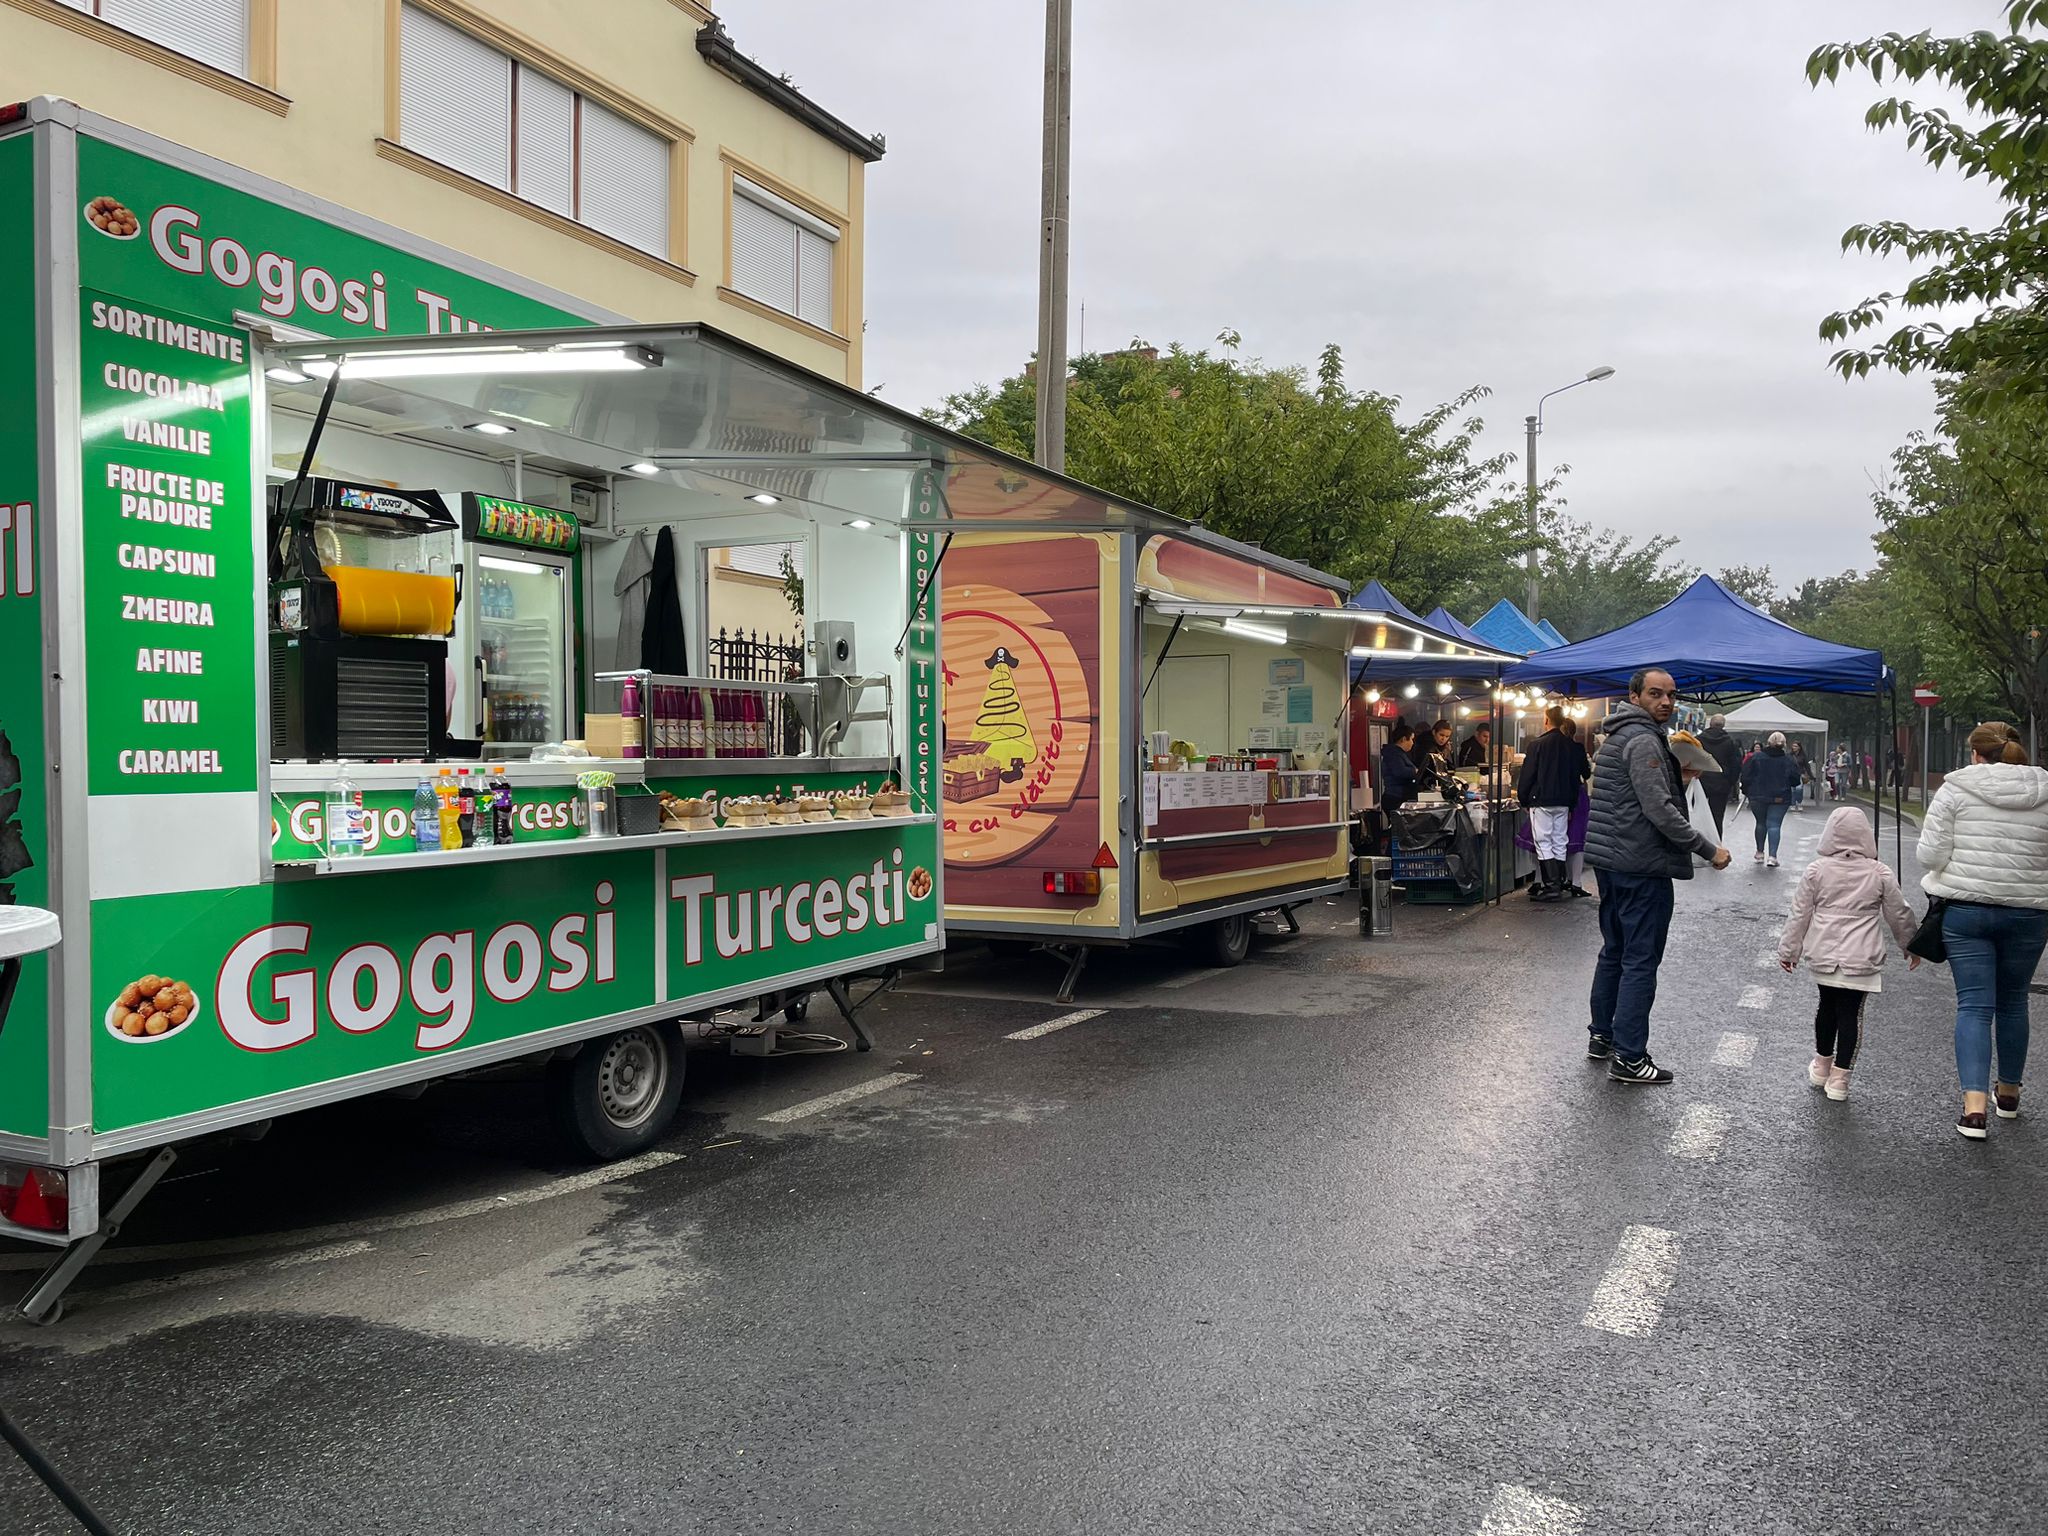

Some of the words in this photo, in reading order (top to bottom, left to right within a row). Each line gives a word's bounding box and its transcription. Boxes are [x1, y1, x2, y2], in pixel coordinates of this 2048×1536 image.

[149, 203, 388, 332] Gogosi
[91, 300, 244, 364] SORTIMENTE
[103, 361, 225, 412] CIOCOLATA
[121, 415, 211, 456] VANILIE
[106, 462, 193, 501] FRUCTE
[195, 478, 225, 506] DE
[121, 492, 213, 530] PADURE
[117, 542, 216, 578] CAPSUNI
[121, 594, 215, 627] ZMEURA
[136, 647, 203, 675] AFINE
[142, 699, 199, 724] KIWI
[916, 659, 929, 815] Turcesti
[118, 749, 224, 774] CARAMEL
[968, 815, 1001, 834] cu
[214, 880, 616, 1055] Gogosi
[671, 847, 905, 966] Turcesti
